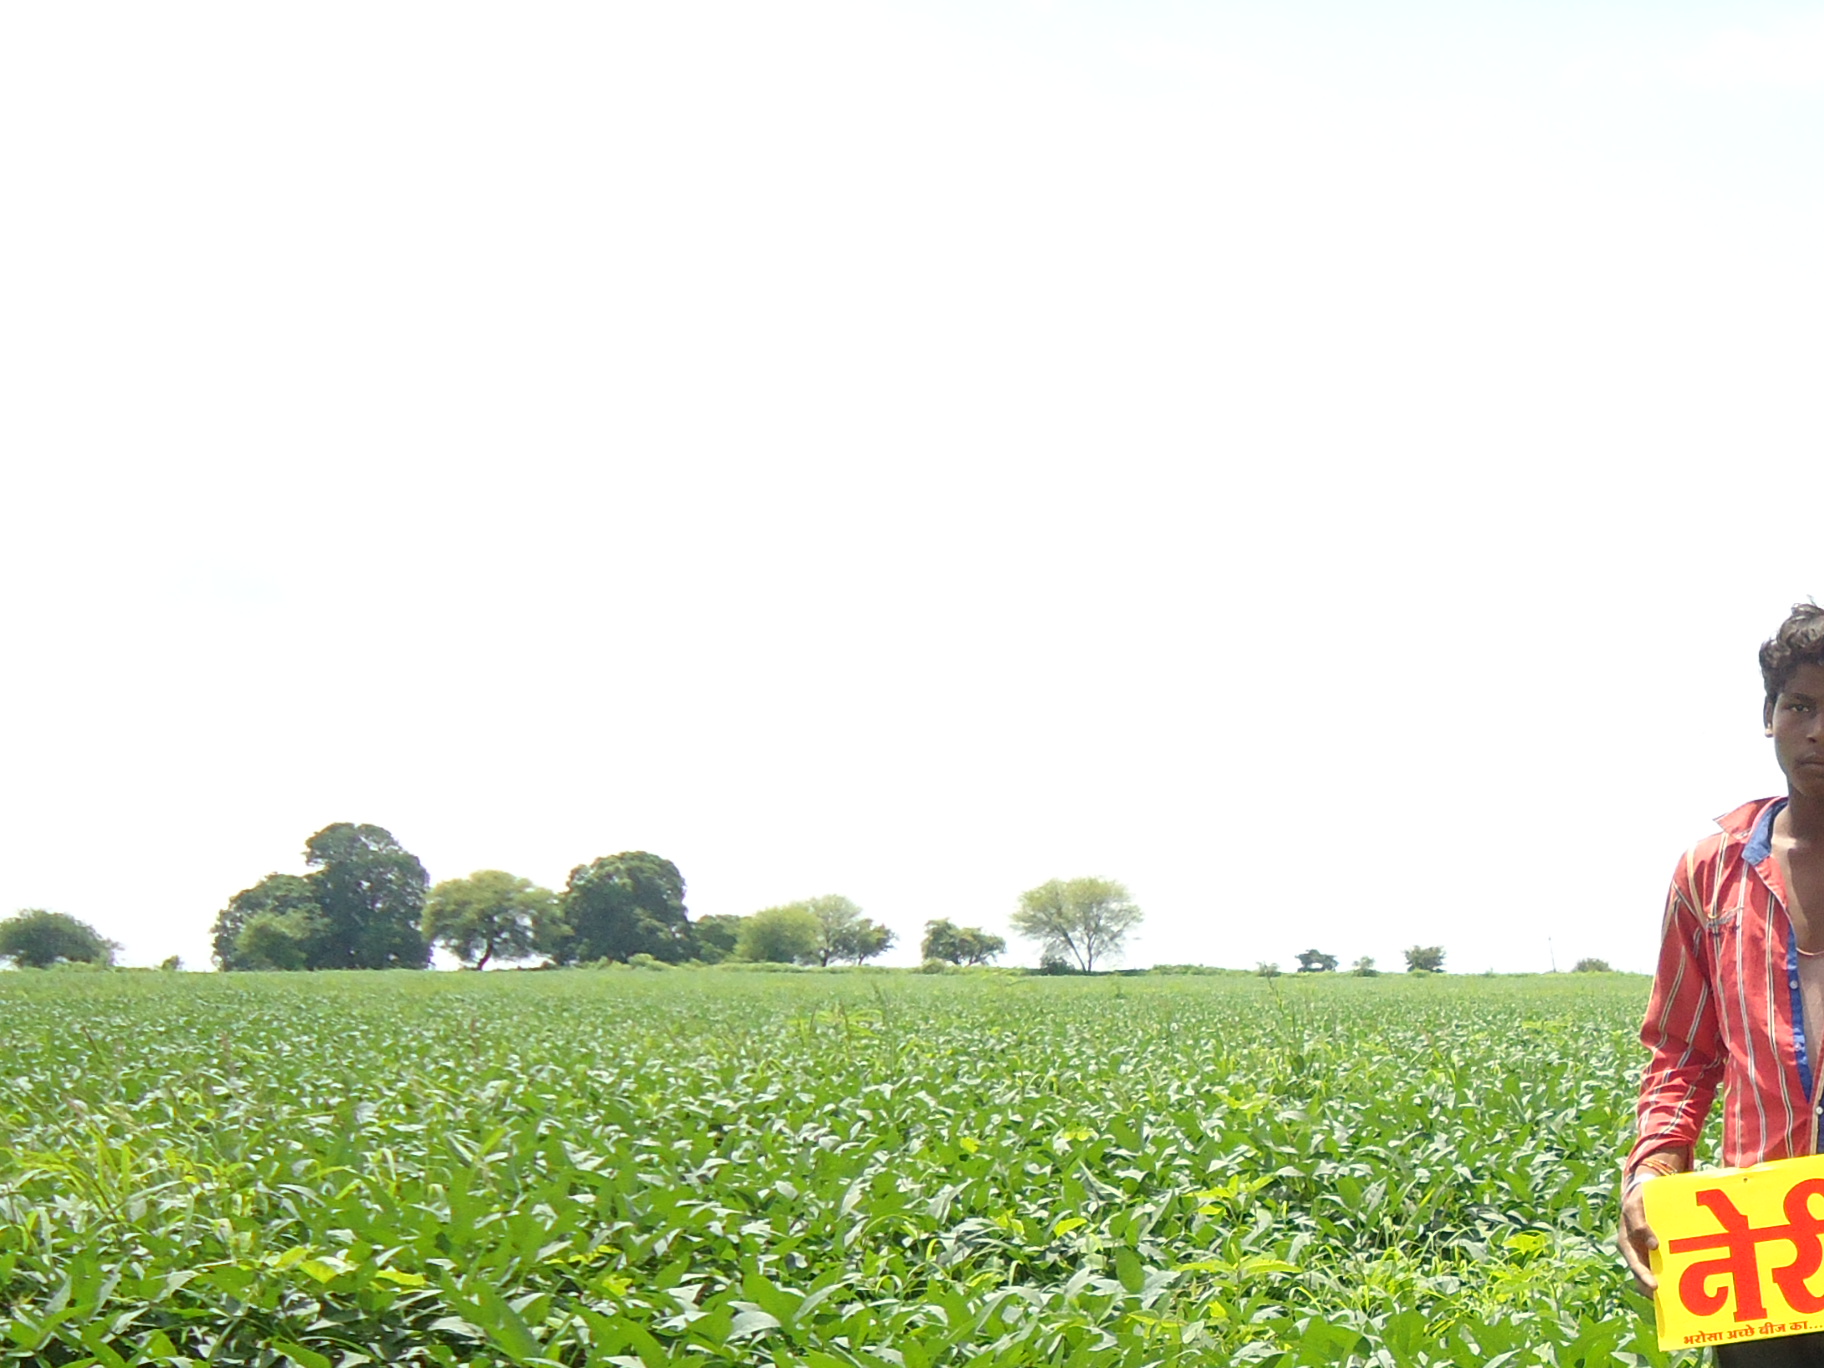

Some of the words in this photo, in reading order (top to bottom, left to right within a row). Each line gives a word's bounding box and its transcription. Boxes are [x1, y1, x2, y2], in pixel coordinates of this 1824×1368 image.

[1684, 1331, 1723, 1345] भरोसा
[1727, 1324, 1755, 1339] अच्छे
[1759, 1322, 1786, 1335] बीज
